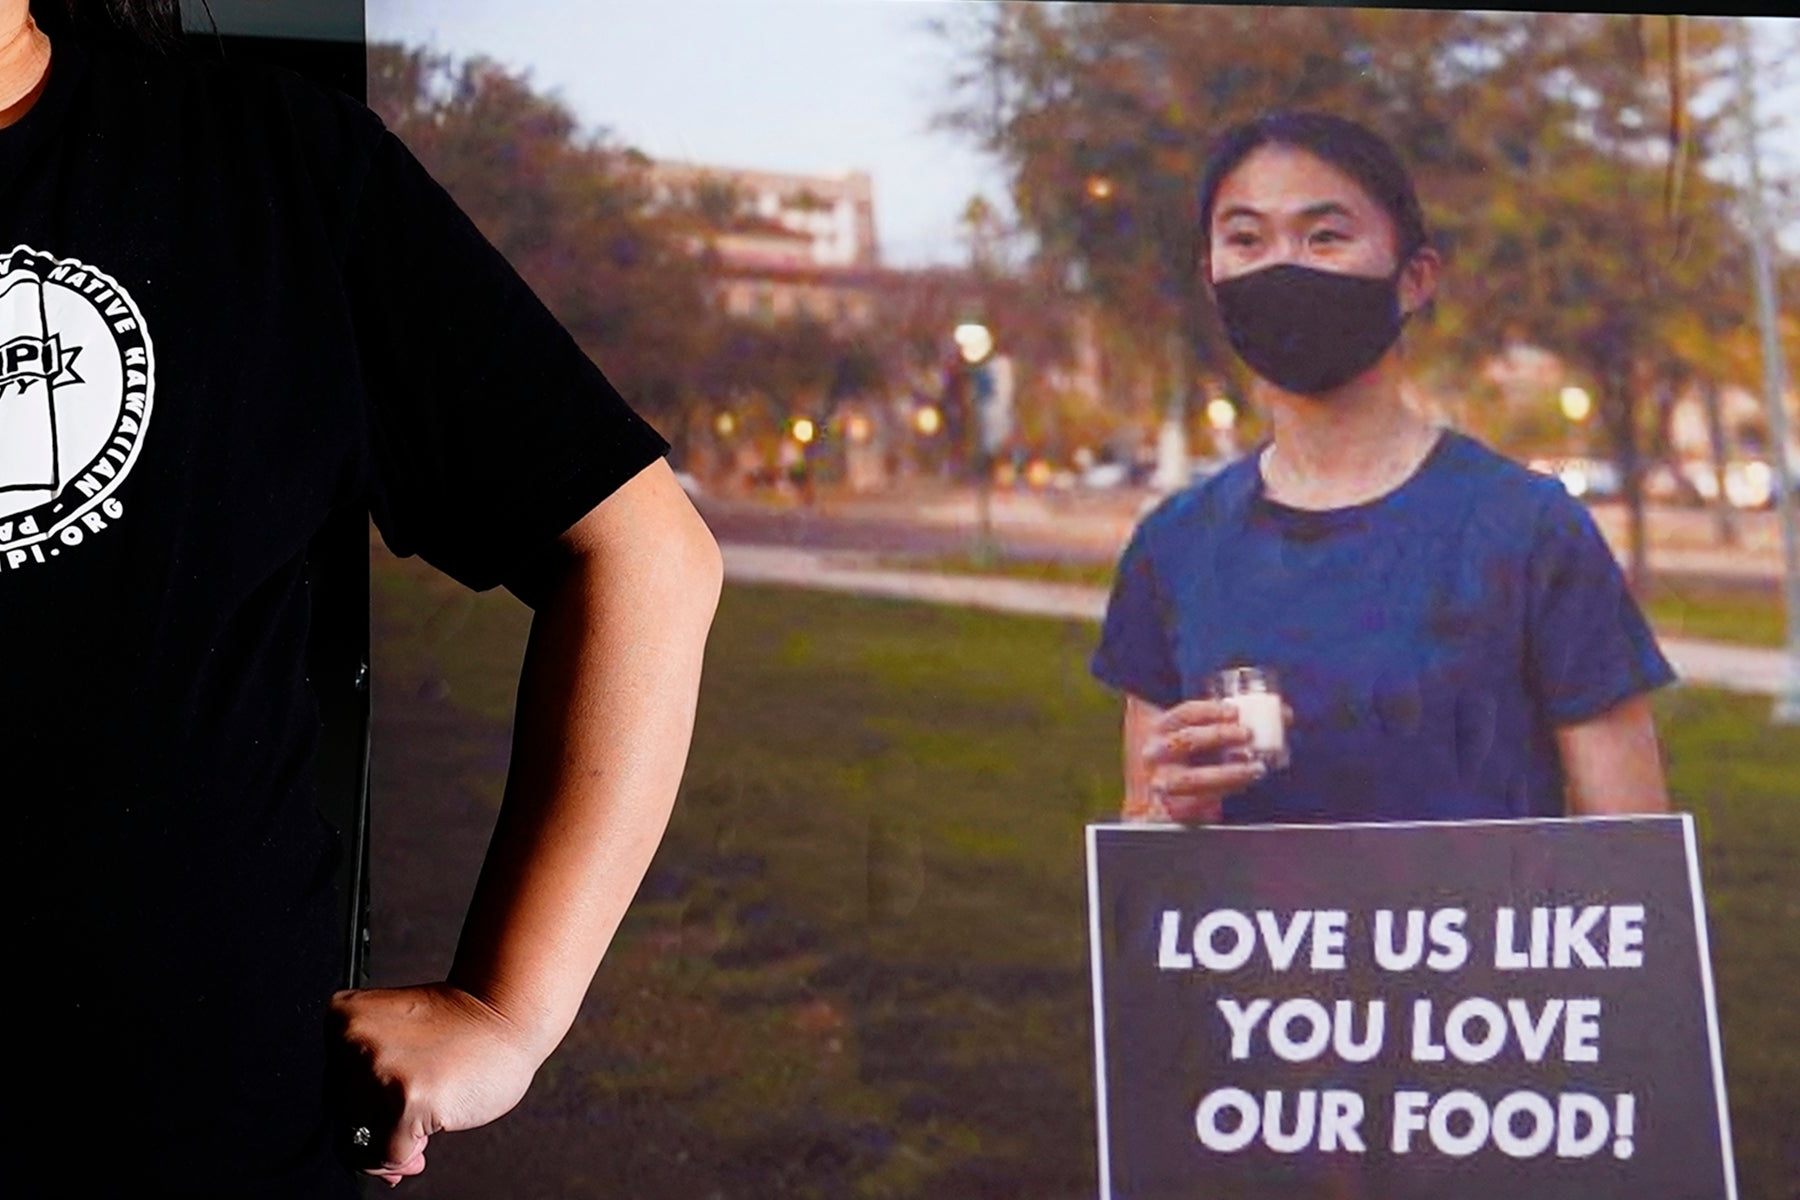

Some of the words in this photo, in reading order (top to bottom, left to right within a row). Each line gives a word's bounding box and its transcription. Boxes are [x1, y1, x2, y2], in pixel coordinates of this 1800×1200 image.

[47, 265, 137, 335] NATIVE
[73, 346, 147, 498] HAWAIIAN
[1157, 909, 1348, 971] LOVE
[1373, 909, 1468, 971] US
[1495, 904, 1645, 969] LIKE
[1216, 997, 1386, 1063] YOU
[1410, 996, 1602, 1063] LOVE
[1195, 1087, 1367, 1153] OUR
[1391, 1092, 1636, 1159] FOOD!
